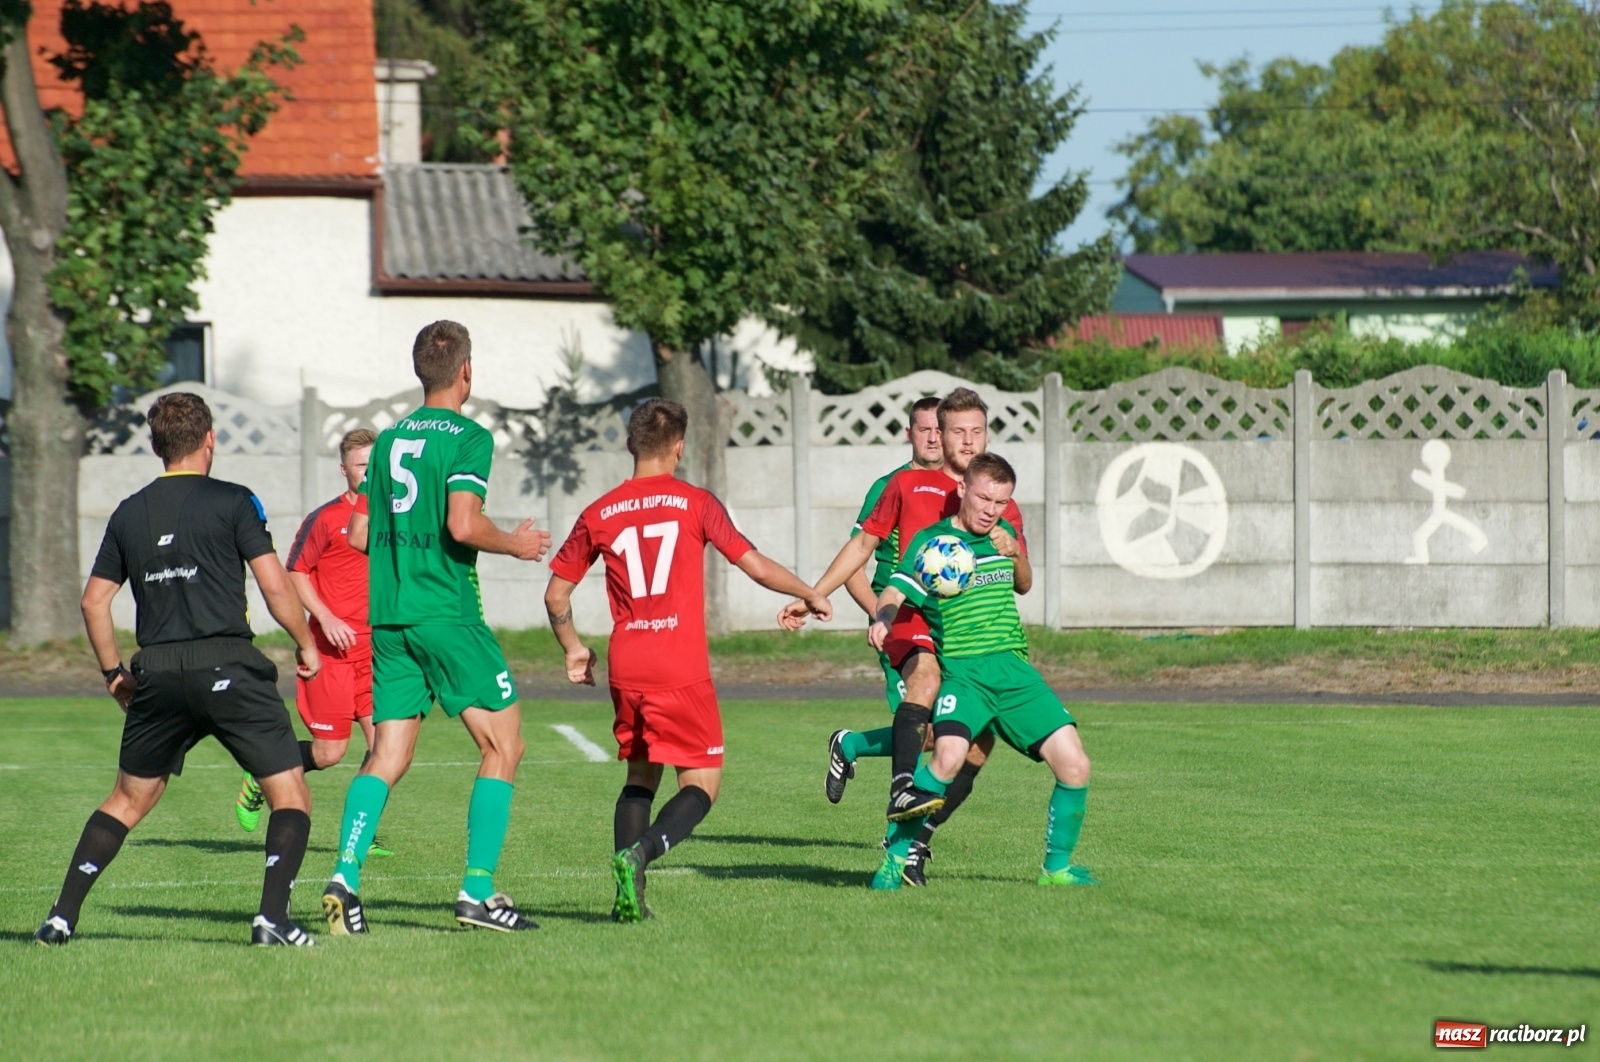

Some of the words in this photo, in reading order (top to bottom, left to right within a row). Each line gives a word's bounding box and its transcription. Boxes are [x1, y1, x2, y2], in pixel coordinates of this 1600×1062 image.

[389, 437, 427, 514] 5
[600, 498, 641, 521] GRANICA
[642, 494, 689, 512] RUPTAWA
[610, 520, 680, 600] 17
[496, 670, 513, 700] 5
[936, 693, 957, 717] 19
